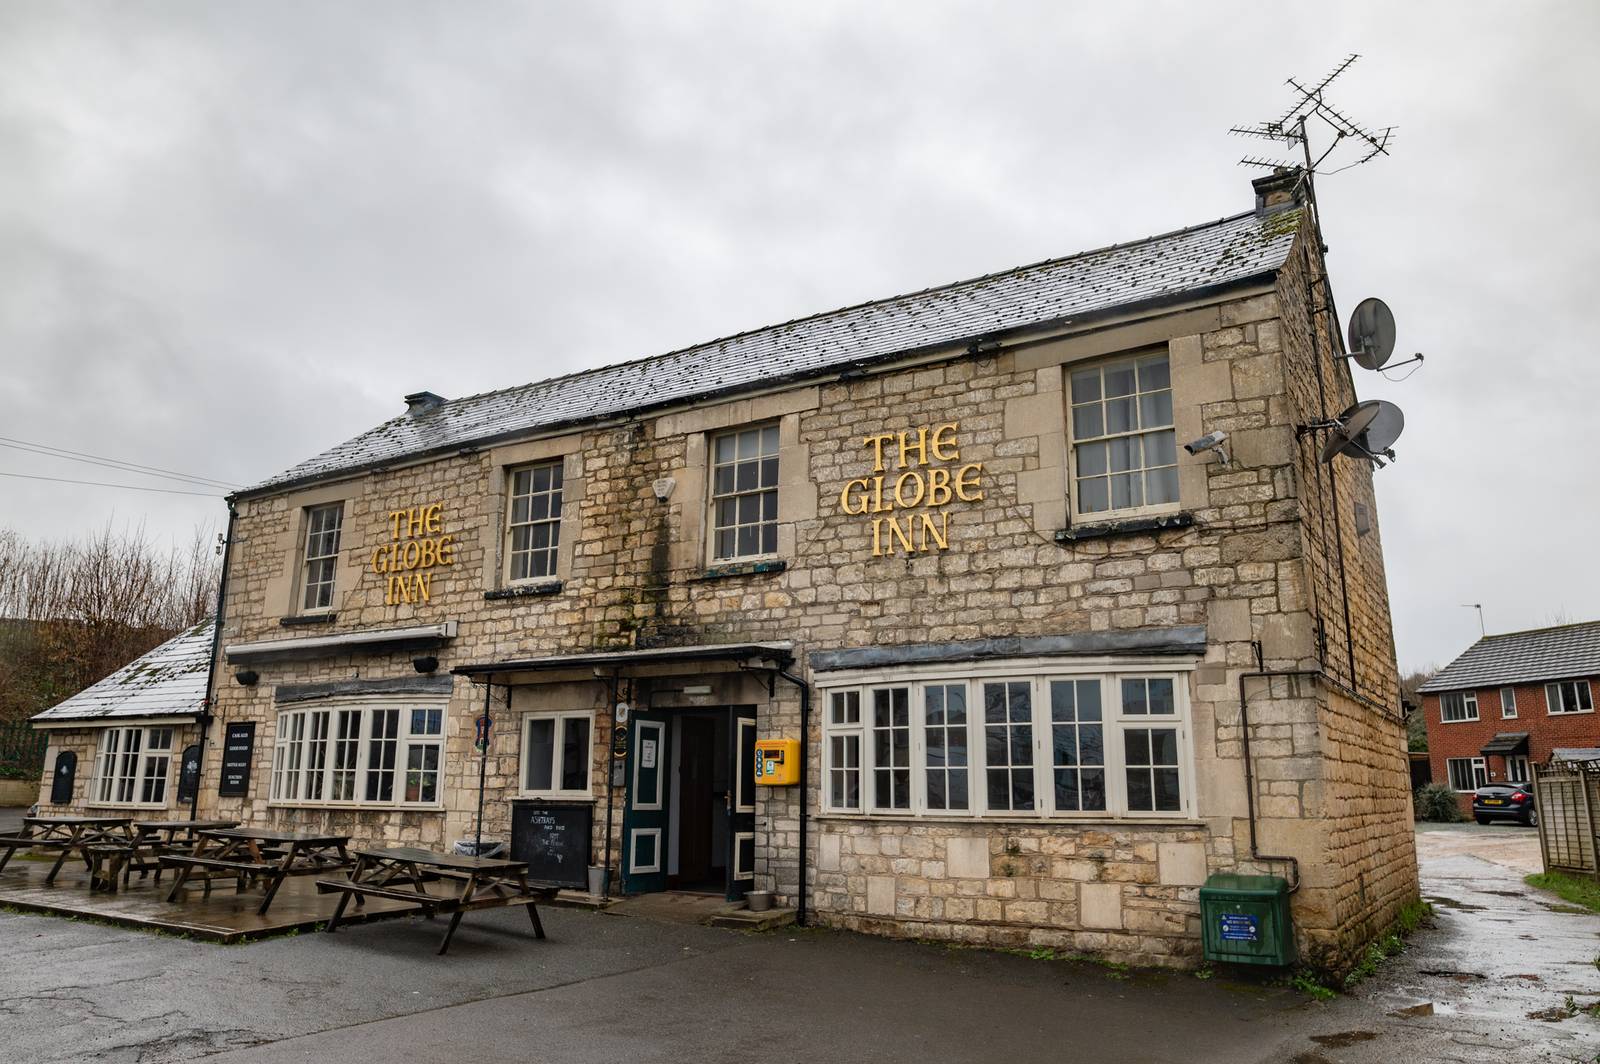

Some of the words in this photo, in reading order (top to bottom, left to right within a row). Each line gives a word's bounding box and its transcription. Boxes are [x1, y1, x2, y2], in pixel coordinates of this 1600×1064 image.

[863, 422, 960, 472] THE
[840, 463, 984, 515] GLOBE
[388, 503, 443, 540] THE
[872, 511, 949, 557] INN
[370, 534, 454, 574] GLOBE
[386, 572, 433, 606] INN
